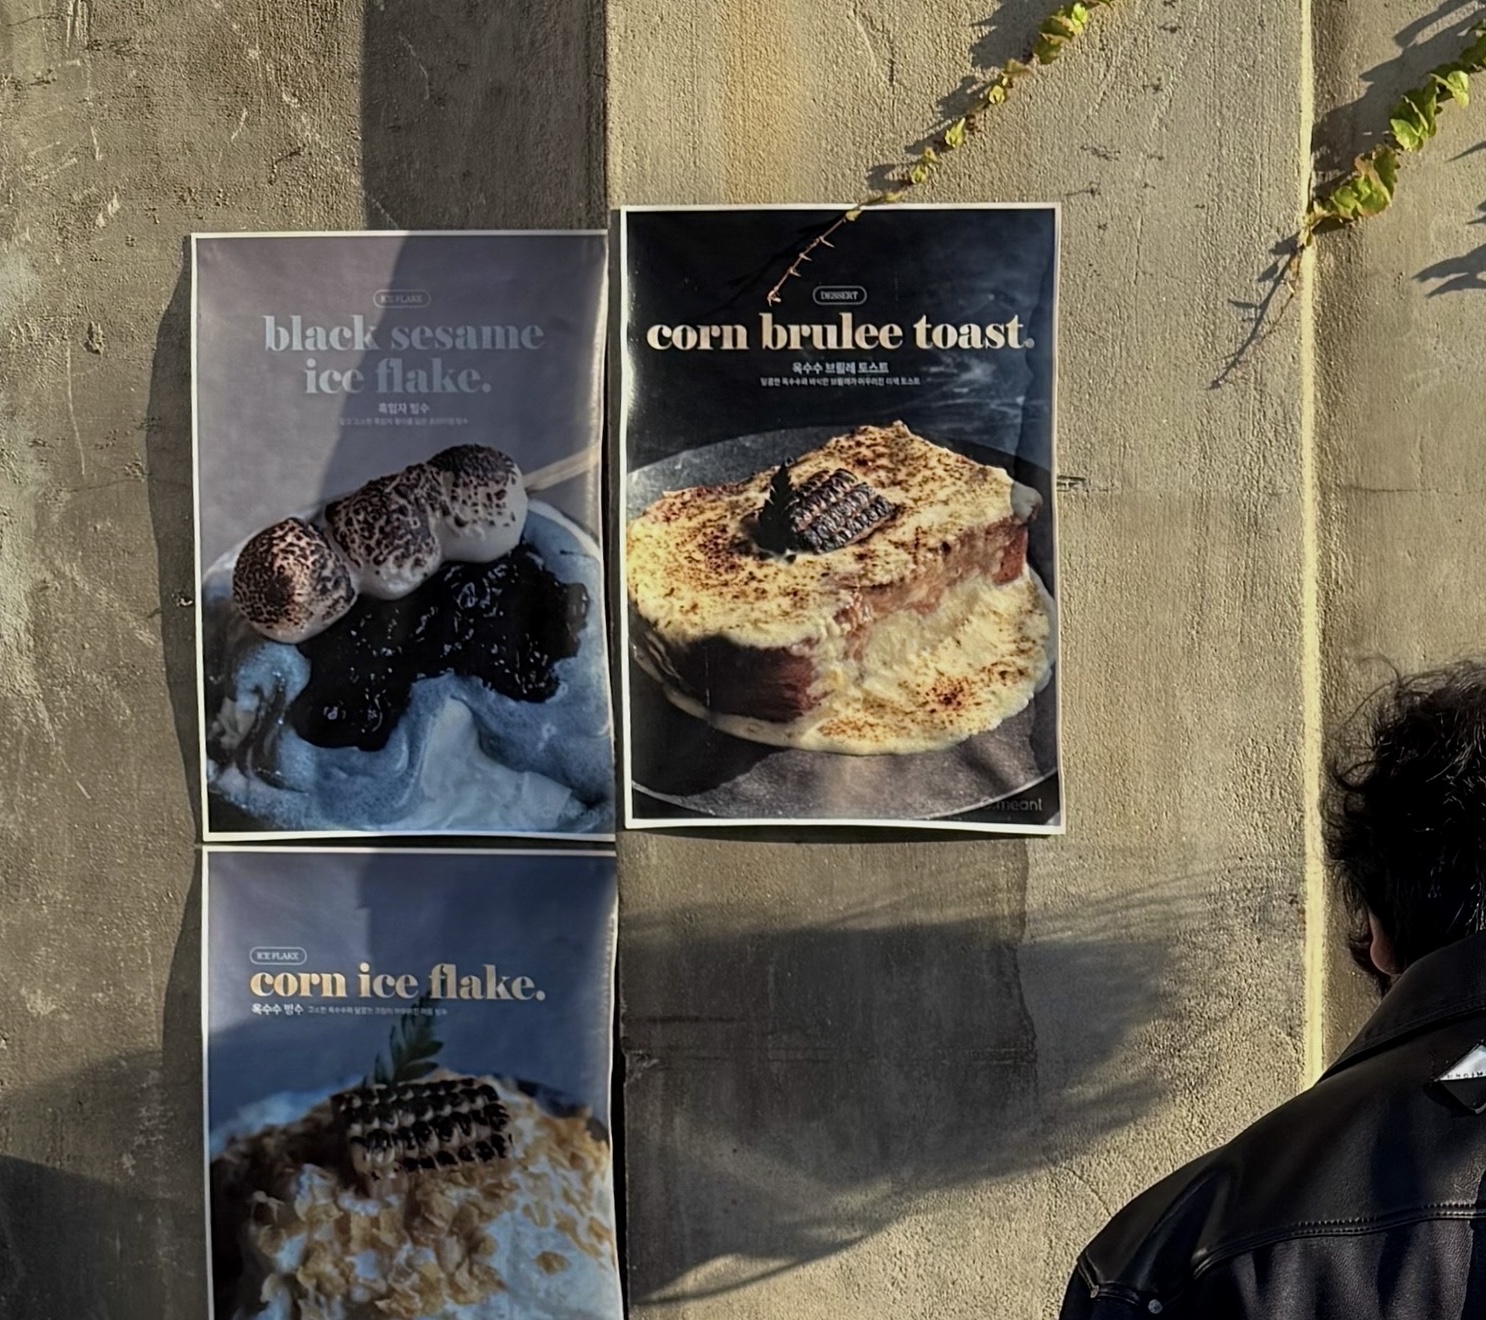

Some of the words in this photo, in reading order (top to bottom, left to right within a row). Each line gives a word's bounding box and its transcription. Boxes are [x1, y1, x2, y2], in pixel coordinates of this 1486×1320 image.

[263, 314, 379, 352] black
[390, 321, 545, 350] sesame
[646, 323, 749, 351] corn
[759, 312, 903, 351] brulee
[913, 314, 1036, 350] toast.
[304, 358, 365, 395] ice
[375, 357, 492, 395] flake.
[792, 362, 823, 374] 옥수수
[858, 362, 889, 373] 토스트
[250, 972, 347, 997] corn
[358, 962, 419, 998] ice
[428, 963, 546, 1001] flake.
[251, 1003, 282, 1015] 옥수수
